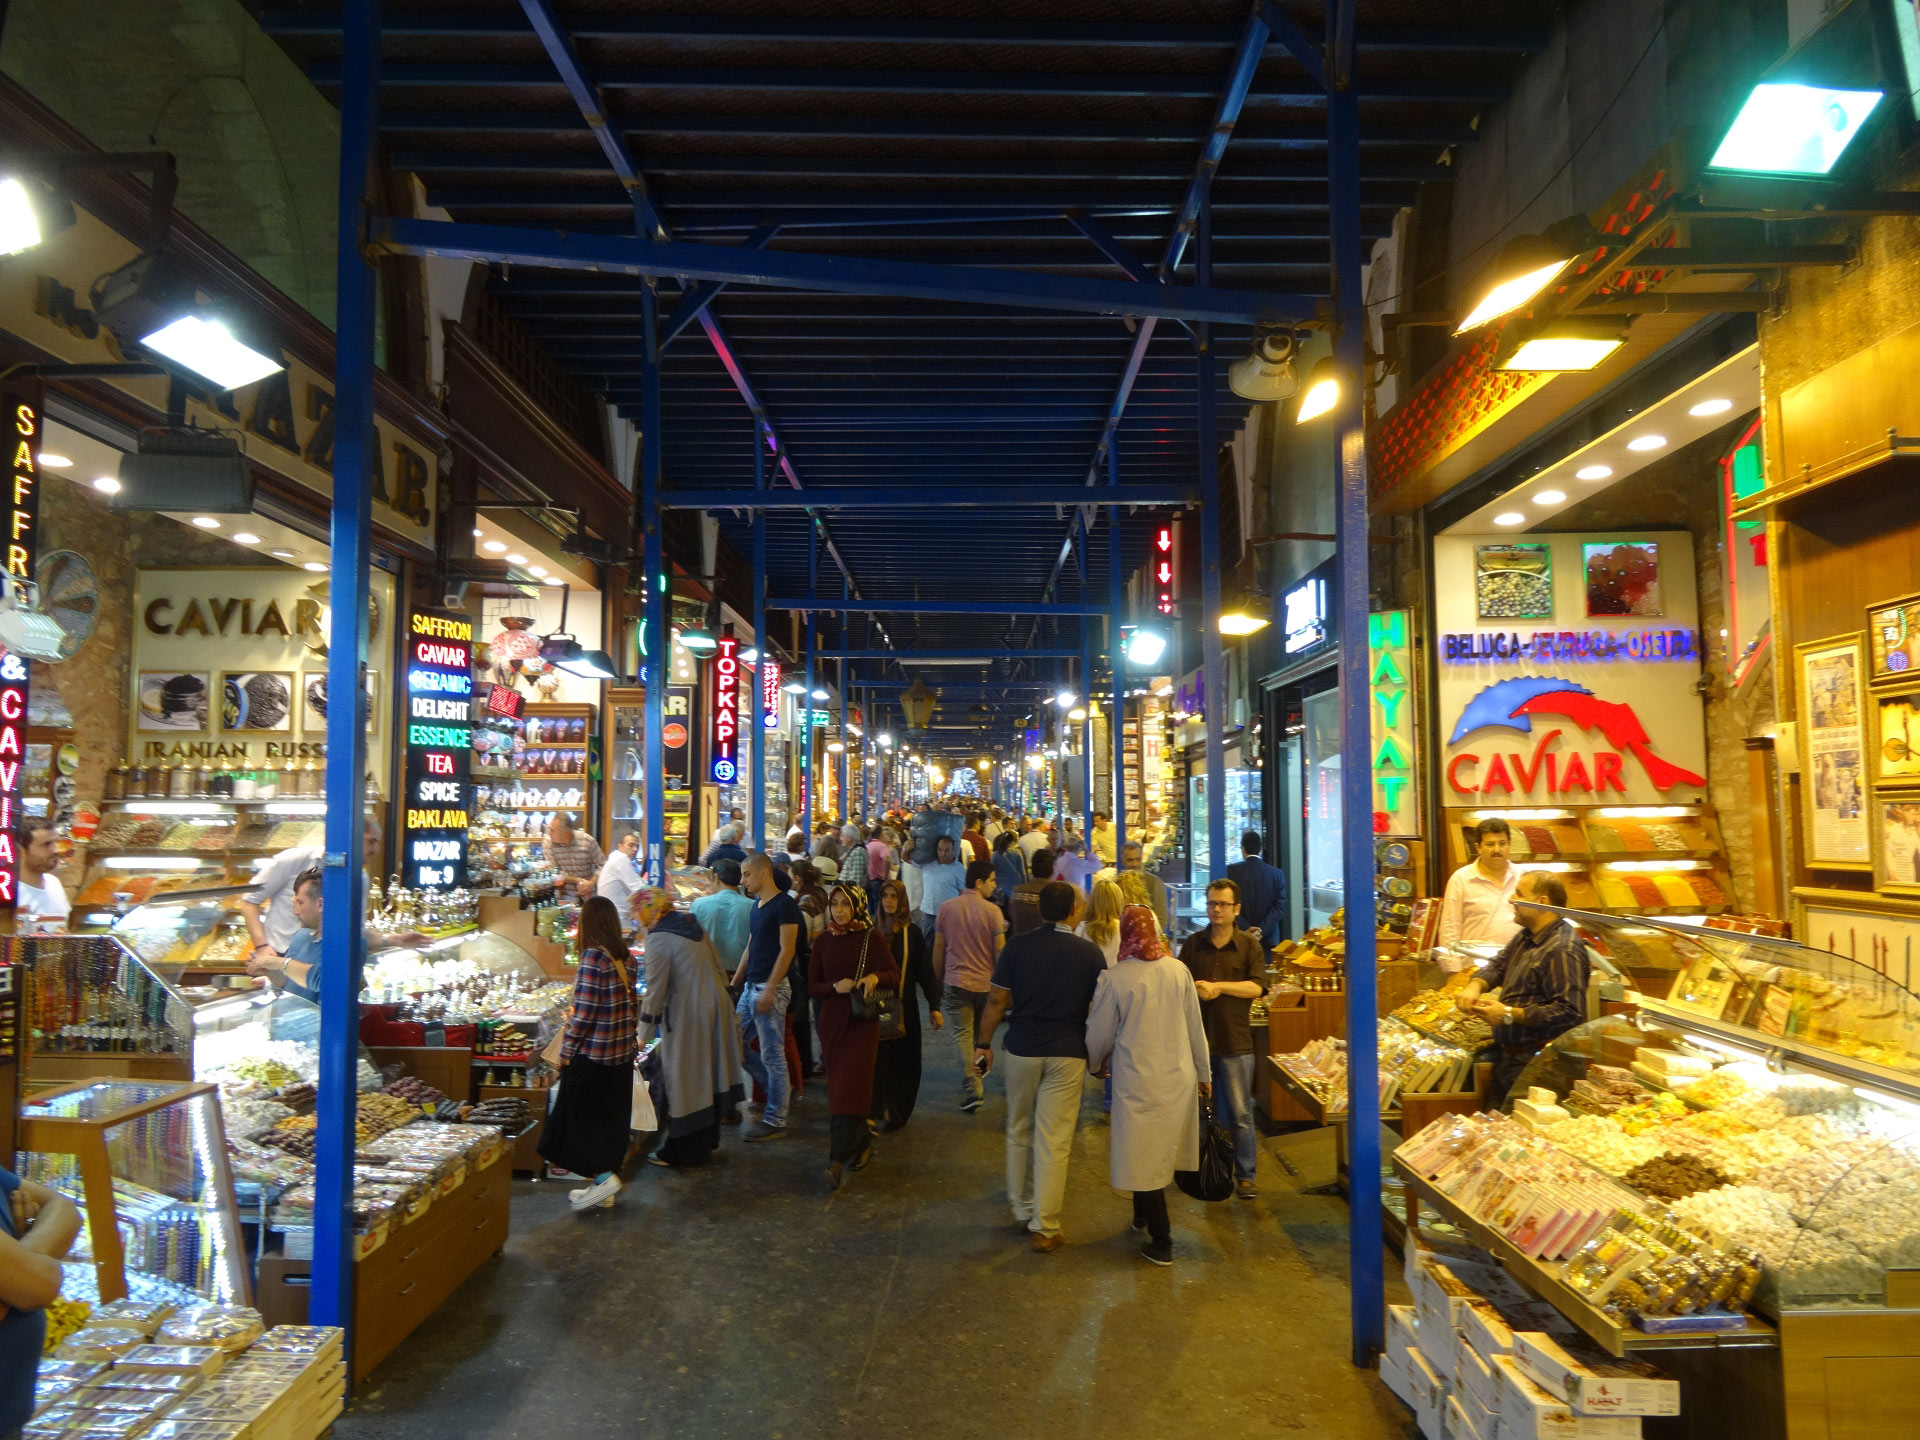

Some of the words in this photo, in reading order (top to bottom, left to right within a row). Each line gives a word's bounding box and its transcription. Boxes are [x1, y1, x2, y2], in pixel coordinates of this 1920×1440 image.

[144, 597, 323, 636] CAVIAR
[412, 613, 472, 641] SAFFRON
[1, 654, 28, 681] &
[417, 642, 466, 668] CAVIAR
[409, 669, 472, 695] CERAMIC
[412, 697, 470, 721] DELIGHT
[716, 641, 736, 758] TOPKAPI
[1368, 610, 1407, 812] HAYAT
[410, 725, 471, 748] ESSENCE
[143, 741, 249, 759] IRANIAN
[1447, 728, 1628, 794] CAVIAR
[426, 754, 454, 774] TEA
[419, 781, 461, 802] SPICE
[407, 809, 468, 828] BAKLAVA
[413, 840, 461, 861] NAZAR
